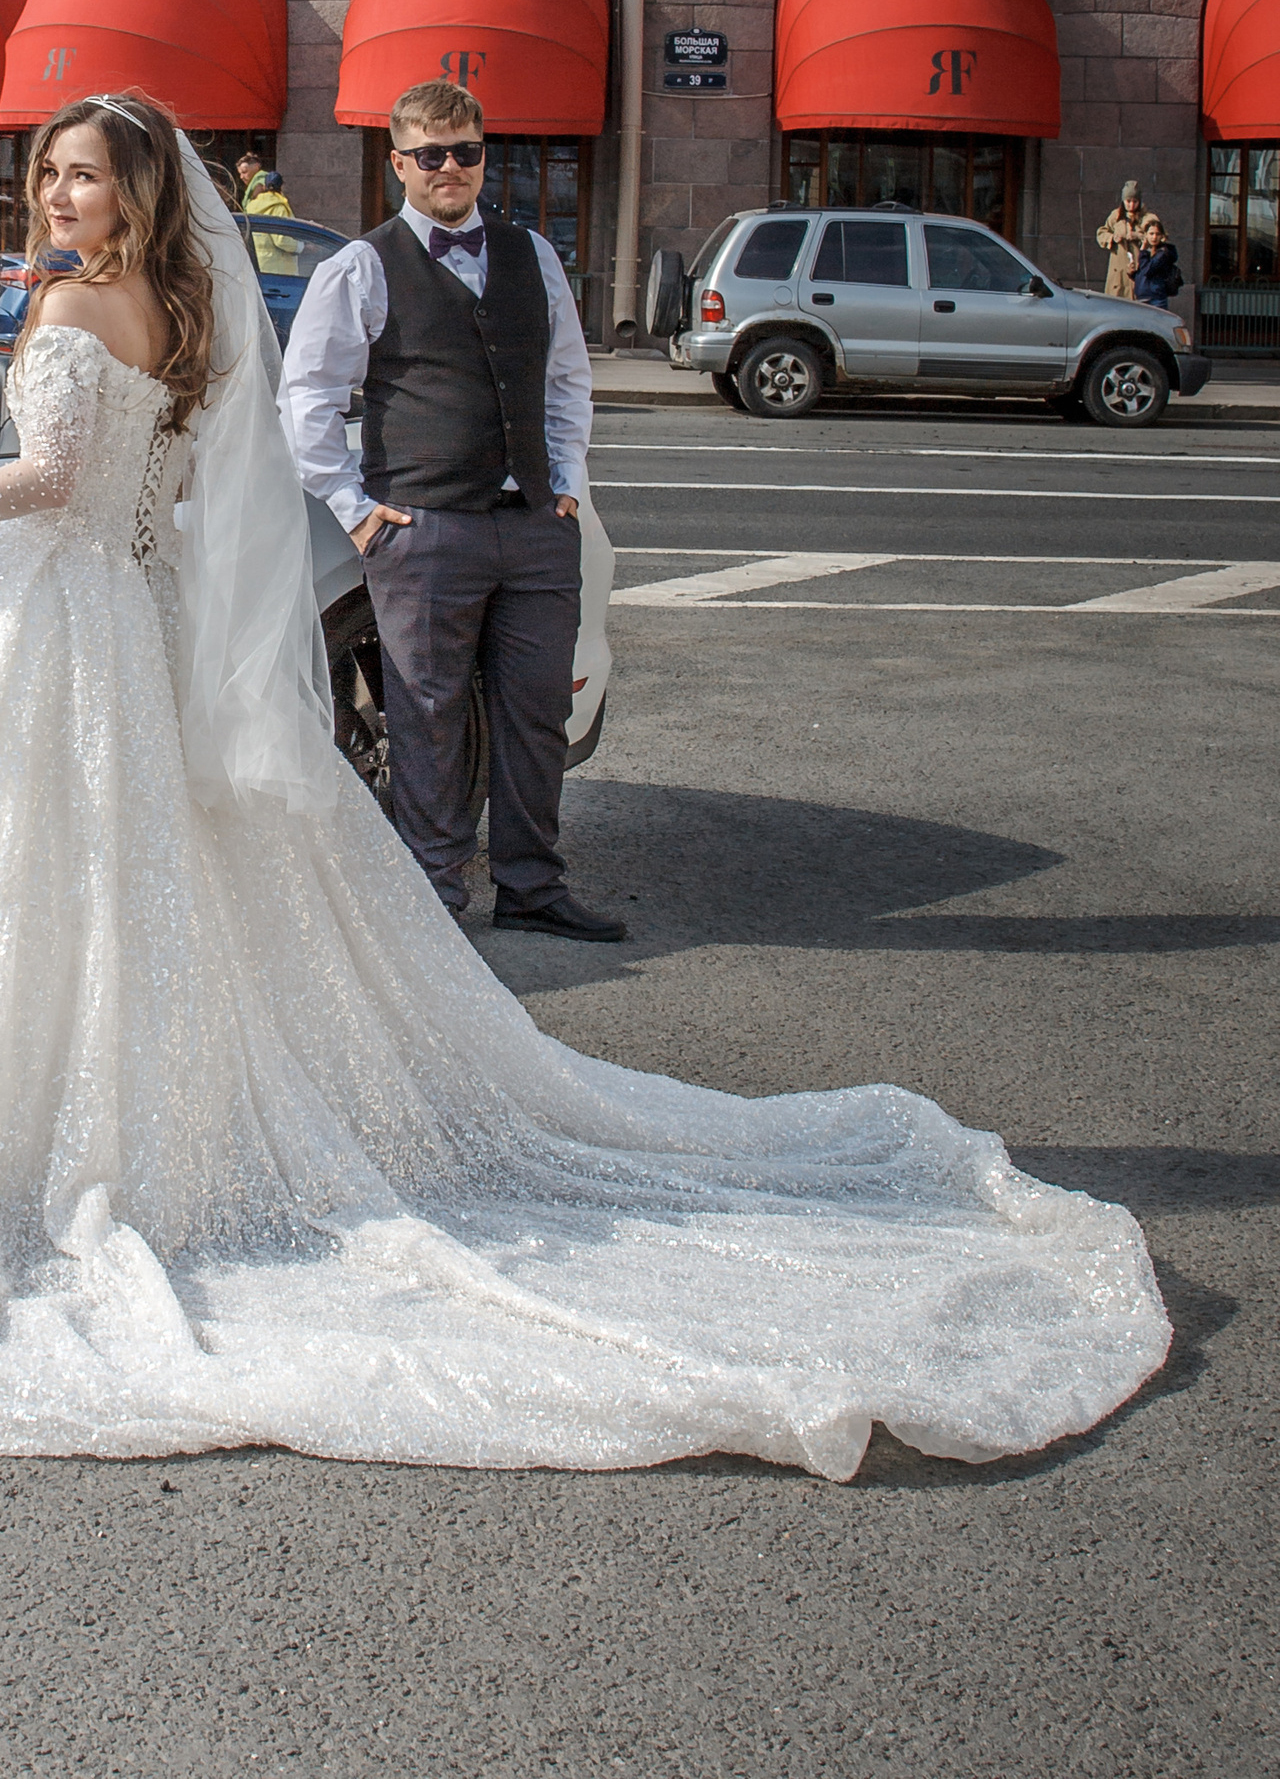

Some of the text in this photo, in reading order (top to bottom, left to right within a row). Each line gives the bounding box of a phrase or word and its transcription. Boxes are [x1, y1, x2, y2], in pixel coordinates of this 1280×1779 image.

[673, 36, 720, 46] БОЛЬШАЯ
[674, 46, 718, 54] МОРСКАЯ
[689, 74, 702, 86] 39
